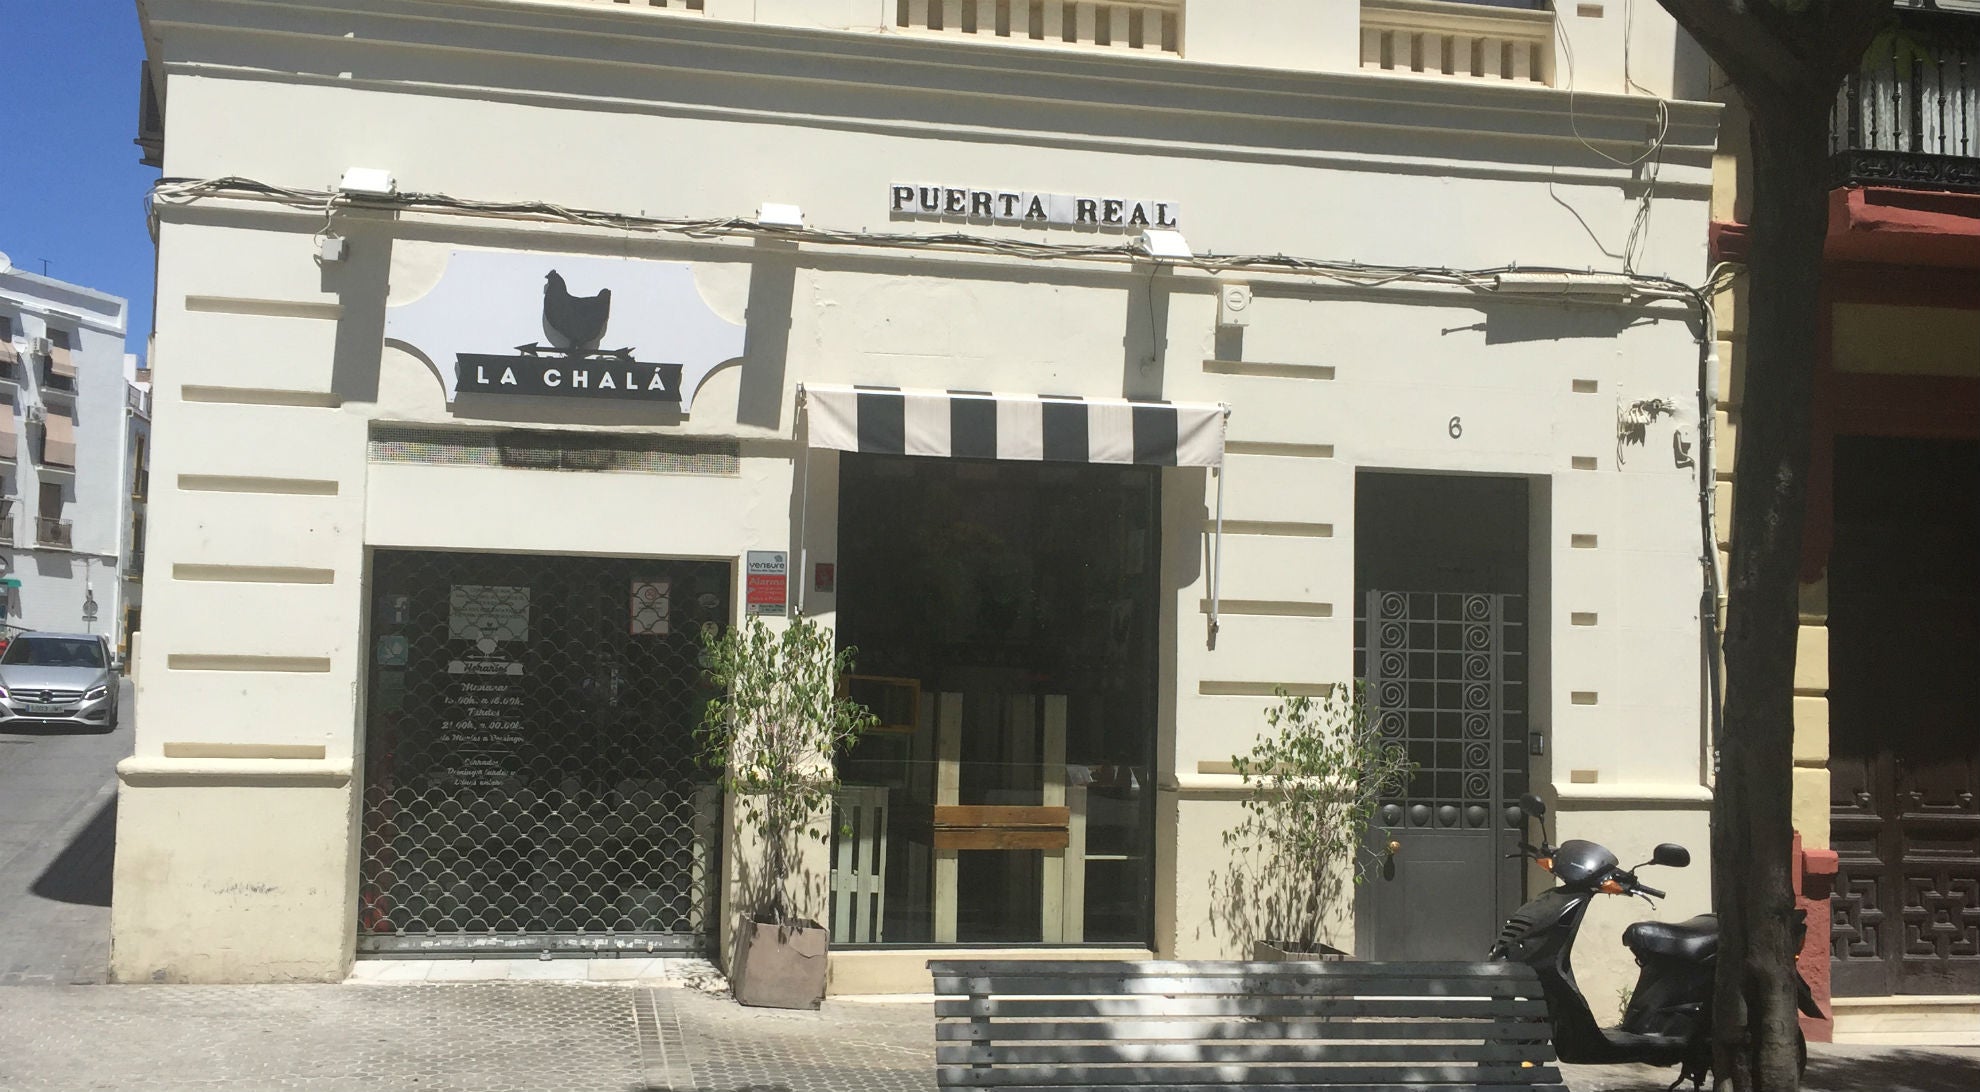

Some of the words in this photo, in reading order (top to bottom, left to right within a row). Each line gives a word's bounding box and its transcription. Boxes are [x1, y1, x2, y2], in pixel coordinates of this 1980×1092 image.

[892, 186, 1047, 221] PUERTA
[1077, 199, 1177, 226] REAL
[477, 366, 518, 385] LA
[543, 367, 666, 391] CHALÁ
[1449, 416, 1462, 439] 6
